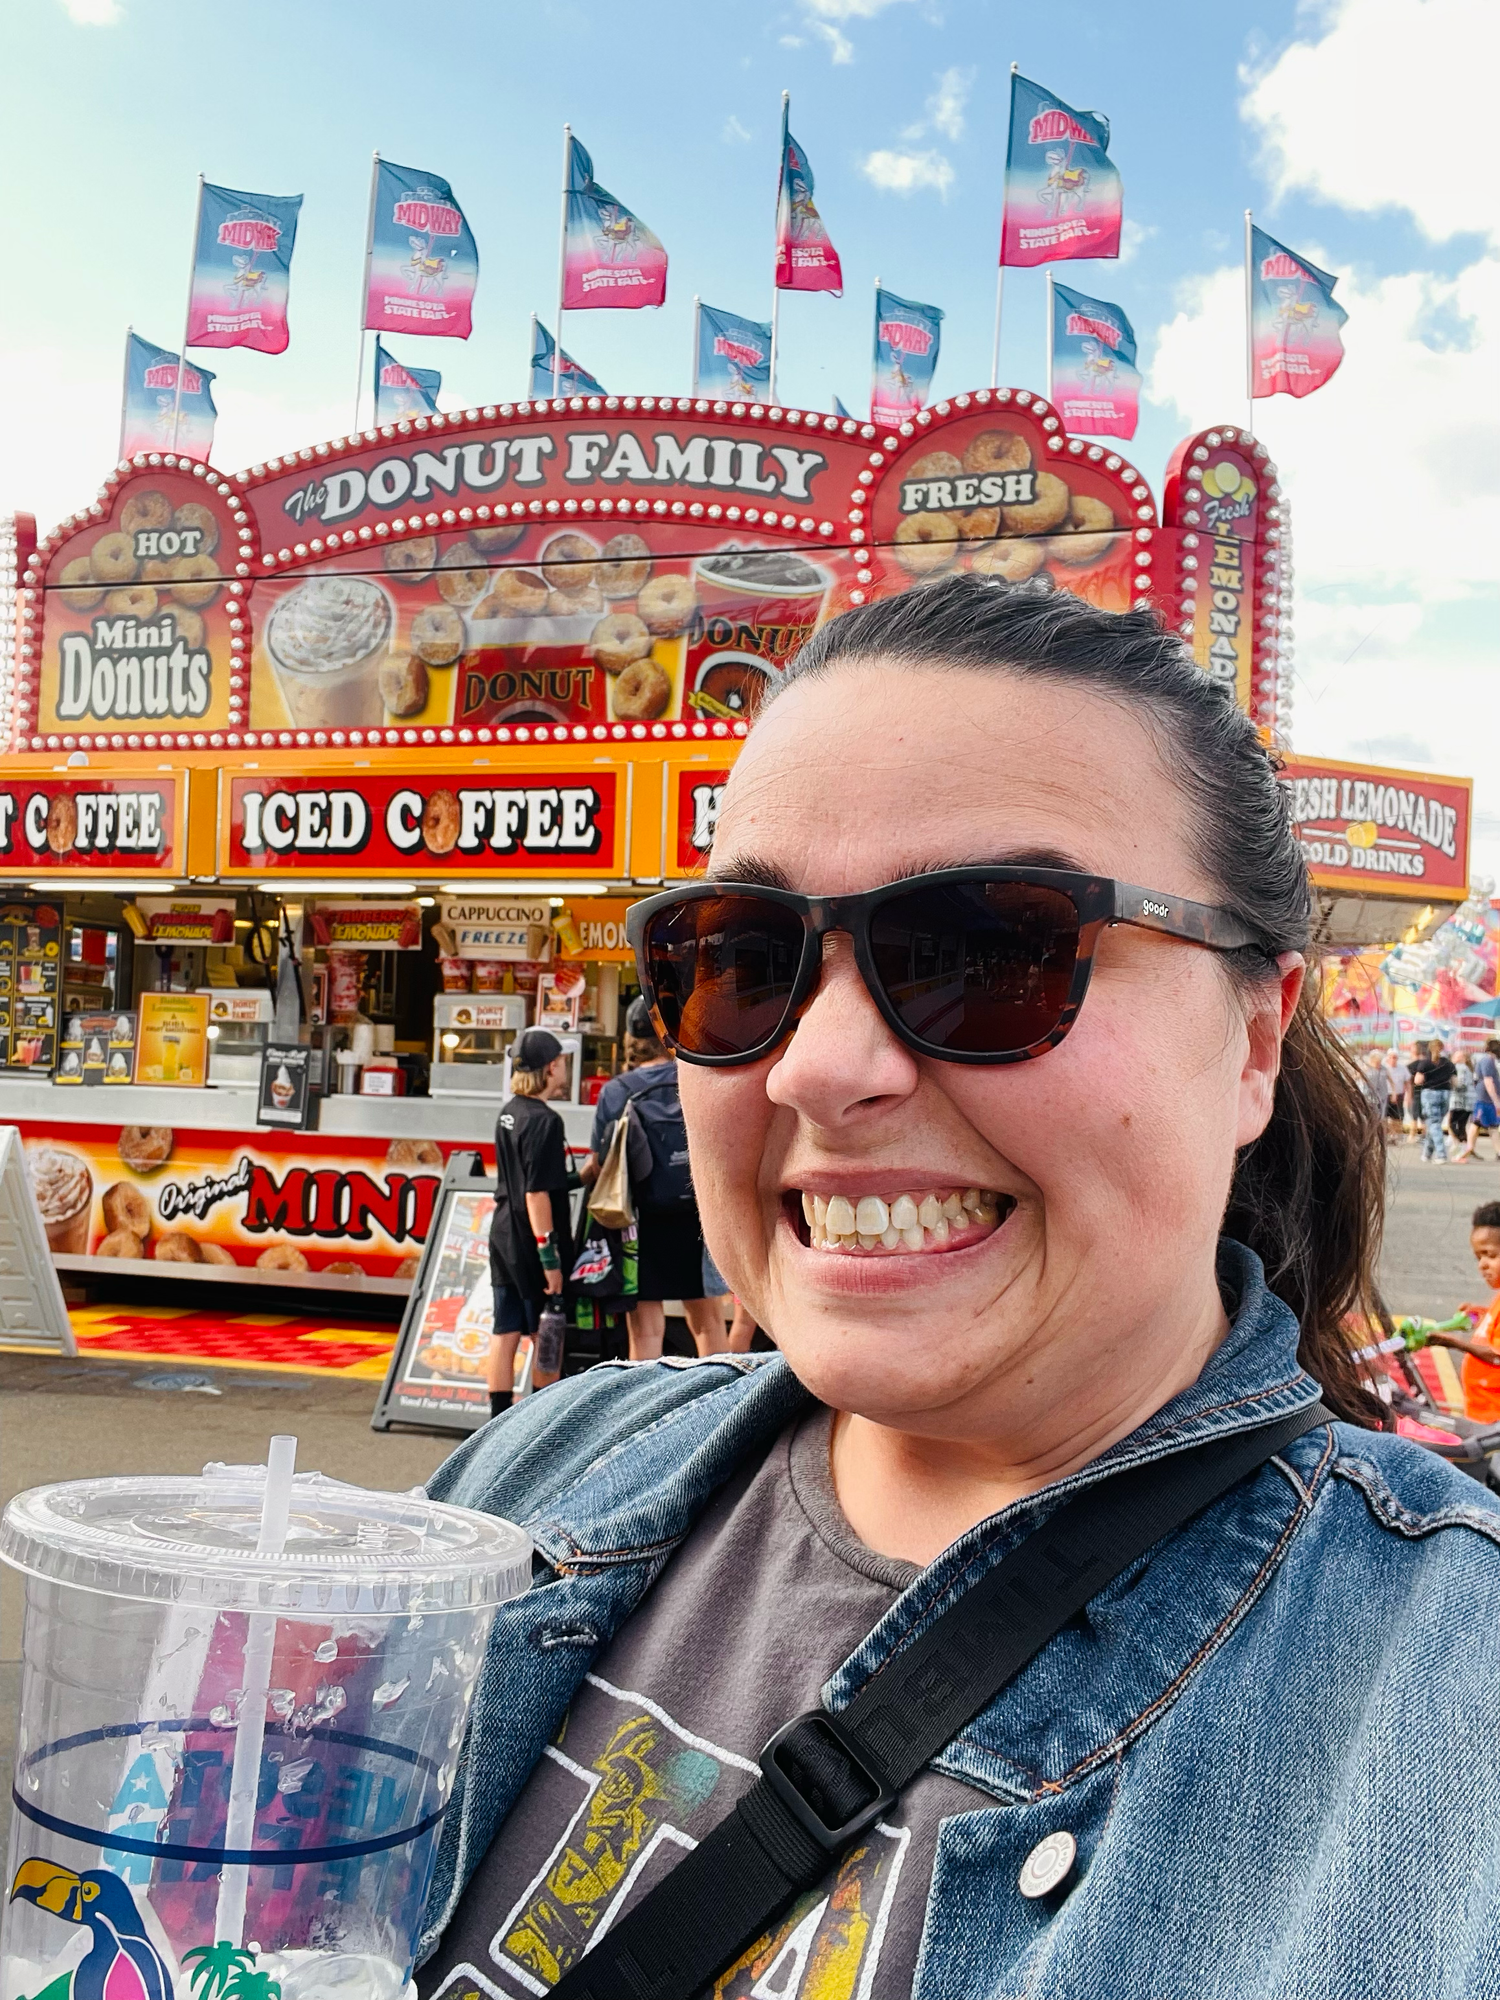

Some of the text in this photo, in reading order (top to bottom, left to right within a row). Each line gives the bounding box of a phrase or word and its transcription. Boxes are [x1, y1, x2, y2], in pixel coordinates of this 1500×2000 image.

[393, 201, 462, 237] MIDWAY
[1019, 219, 1086, 238] MINNESOTA
[1020, 235, 1058, 249] STATE
[384, 296, 446, 311] MINNESOTA
[384, 305, 420, 318] STATE
[285, 432, 826, 523] The DONUT FAMILY
[902, 474, 1035, 511] FRESH
[1203, 493, 1250, 528] Fresh
[136, 530, 201, 556] HOT
[95, 617, 173, 648] Mini
[59, 636, 209, 719] Donuts
[462, 667, 595, 717] DONUT
[243, 791, 368, 849] ICED
[1340, 779, 1457, 858] LEMONADE
[1351, 847, 1424, 876] DRINKS
[447, 906, 544, 922] CAPPUCCINO
[1143, 899, 1169, 918] goodr
[332, 925, 401, 941] LEMONADE
[461, 930, 528, 945] FREEZE
[580, 922, 633, 949] EMON
[476, 1006, 504, 1015] DONUT
[160, 1158, 441, 1242] Original MINI
